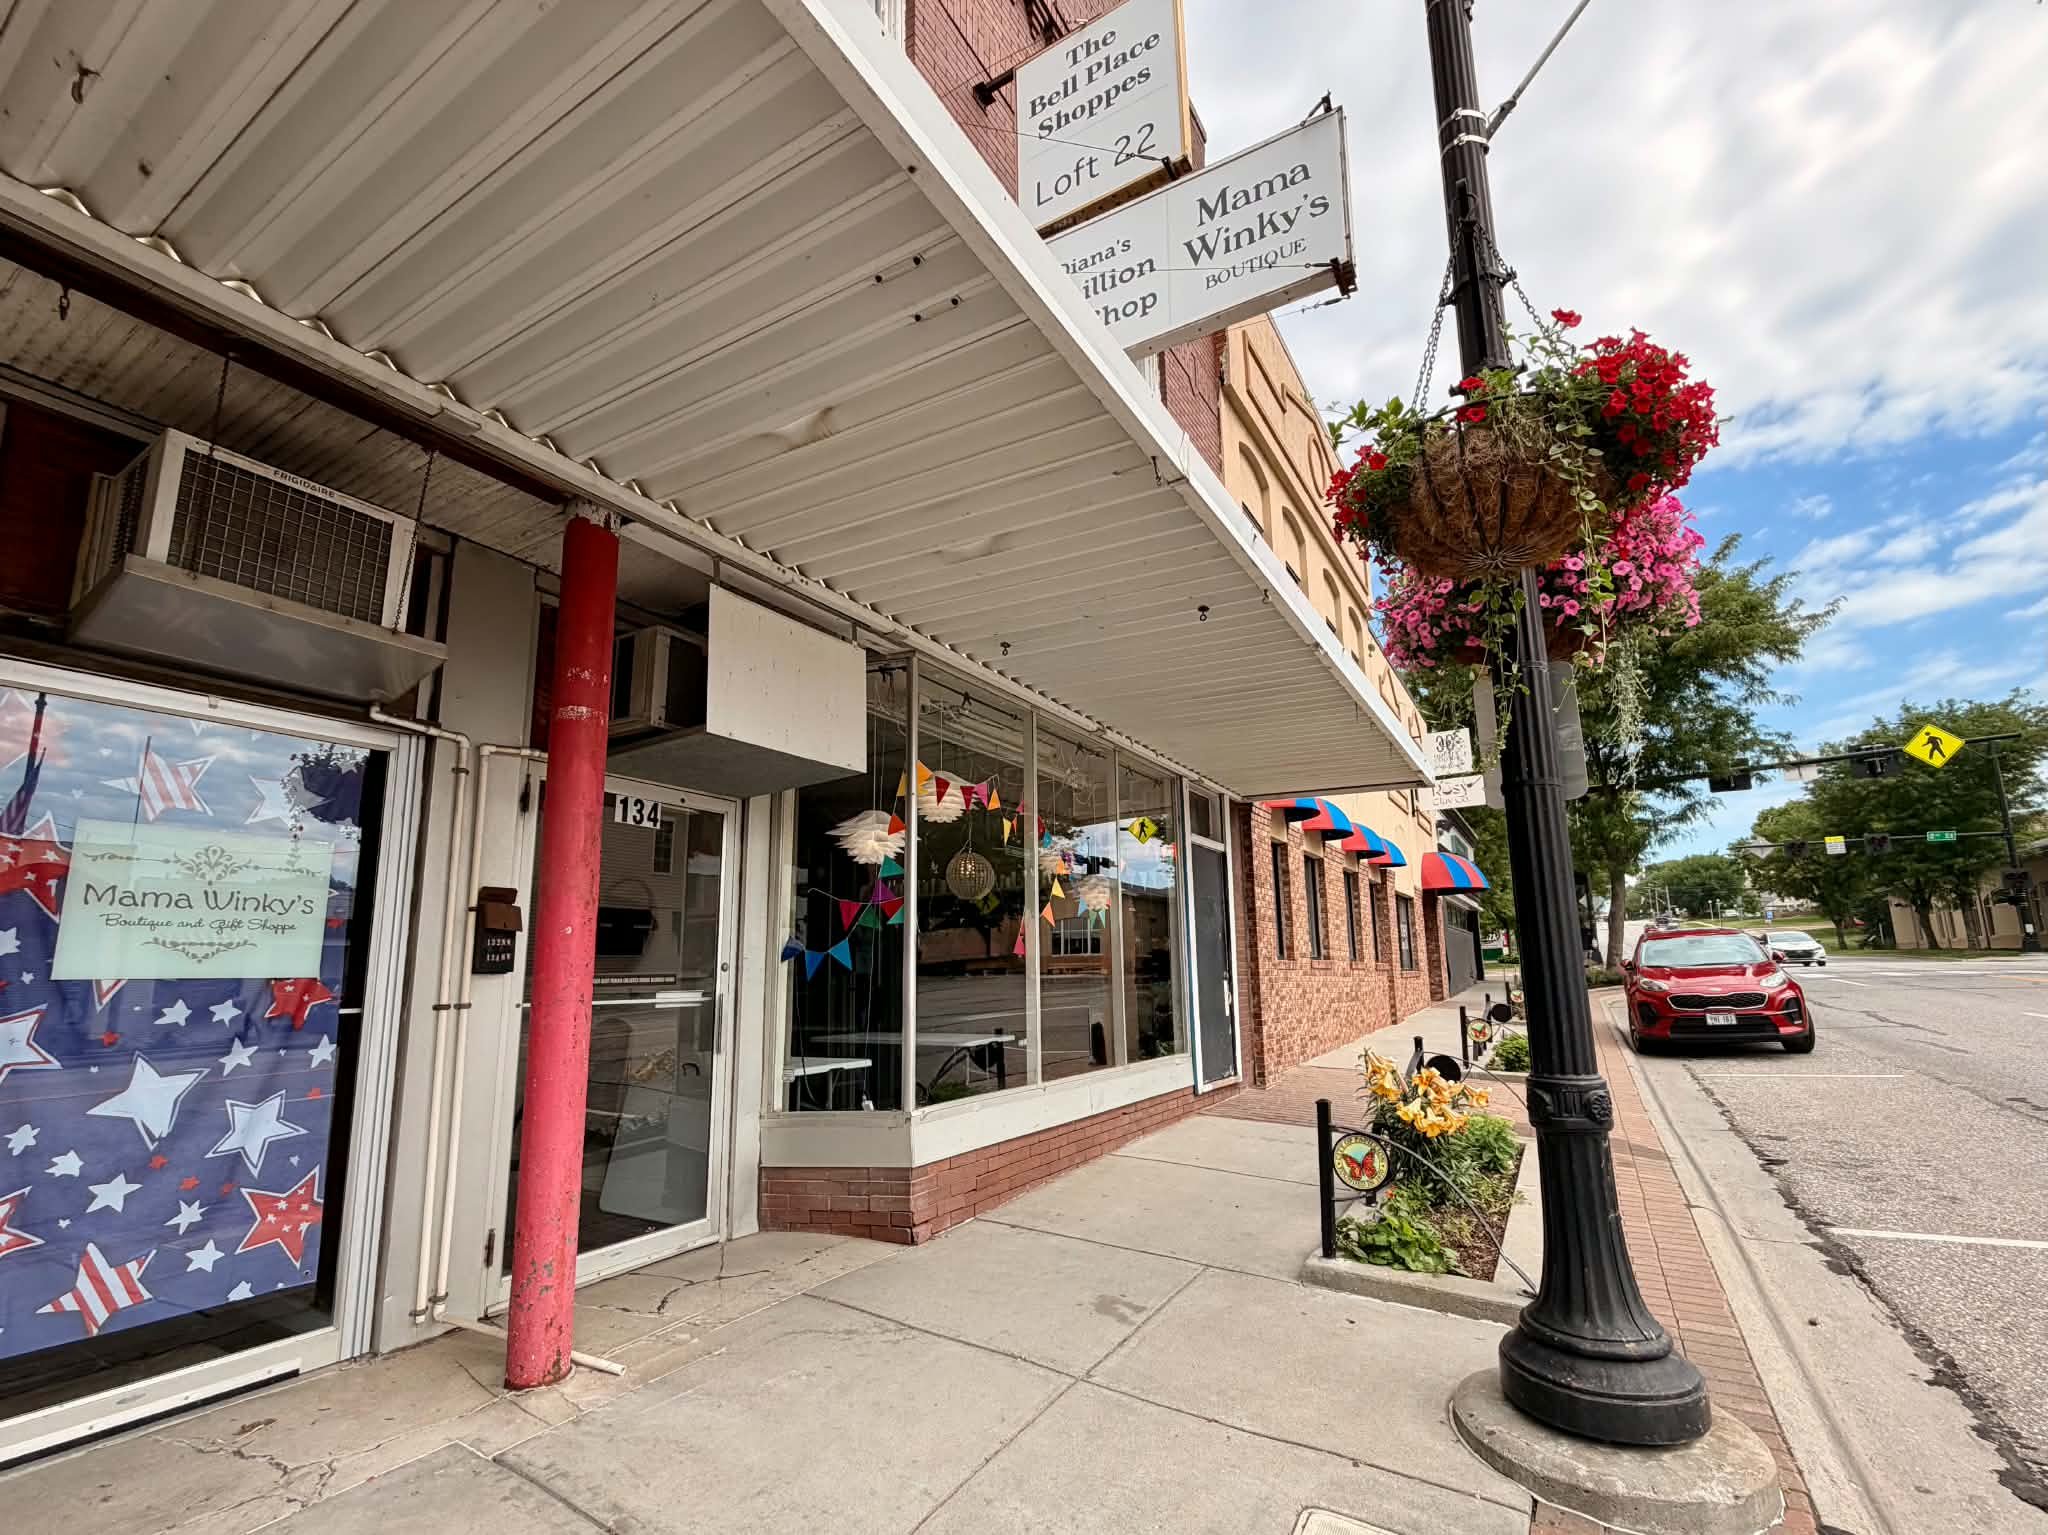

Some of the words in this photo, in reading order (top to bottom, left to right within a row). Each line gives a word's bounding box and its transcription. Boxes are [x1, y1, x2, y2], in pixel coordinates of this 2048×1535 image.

[1065, 30, 1117, 69] The
[1029, 74, 1079, 119] Bell
[1085, 33, 1160, 86] Place
[1038, 67, 1151, 139] Shoppes
[1036, 156, 1100, 207] Loft
[1114, 123, 1156, 167] 22
[1196, 163, 1311, 227] Mama
[1082, 257, 1157, 300] illion
[1205, 238, 1307, 290] BOUTIQUE
[1095, 292, 1158, 326] hop
[273, 470, 335, 498] FRIGIDAIRE
[619, 796, 660, 827] 134
[83, 882, 193, 911] Mama
[203, 888, 314, 915] Winky's
[100, 912, 173, 931] Boutique
[177, 917, 203, 929] and
[210, 918, 244, 935] Gift
[248, 918, 297, 935] Shoppe
